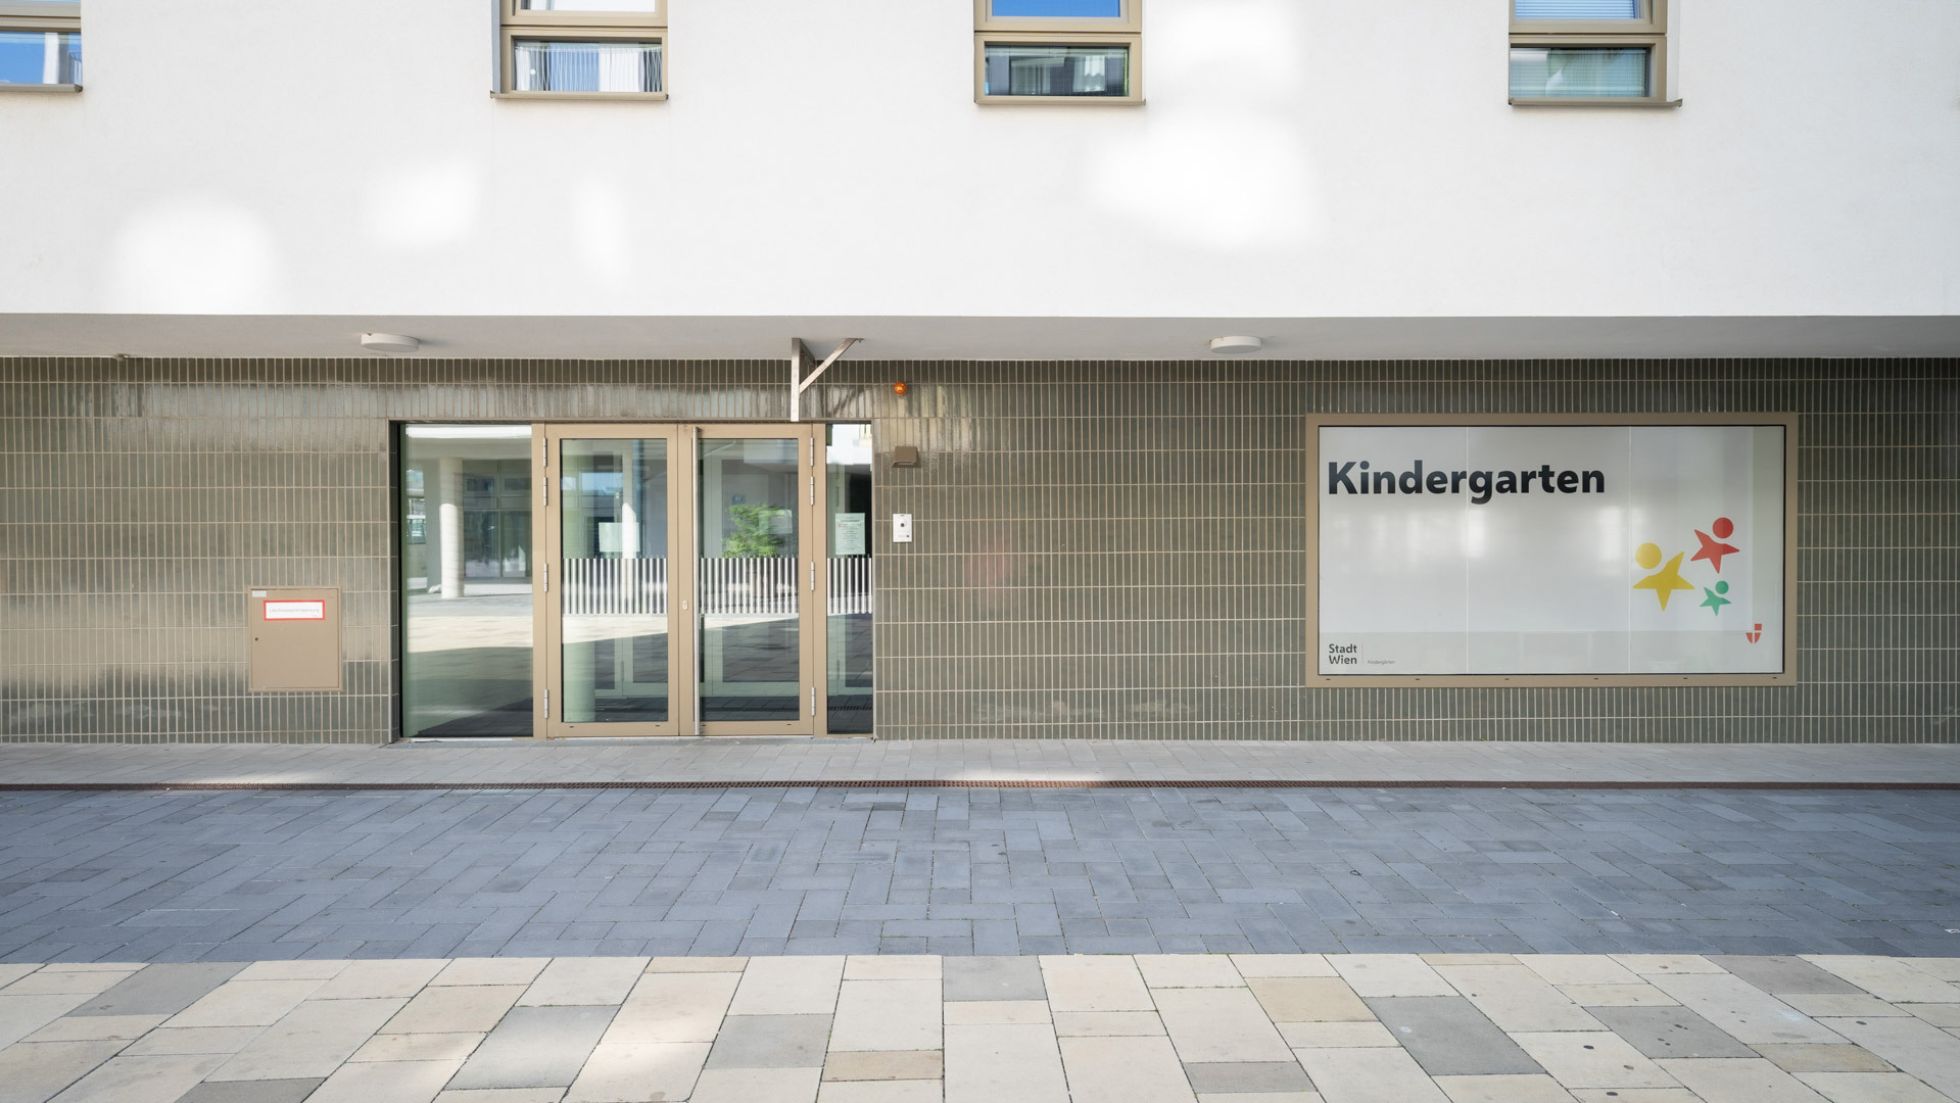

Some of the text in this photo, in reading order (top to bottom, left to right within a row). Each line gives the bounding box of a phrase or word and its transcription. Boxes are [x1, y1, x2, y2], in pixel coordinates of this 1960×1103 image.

[1328, 459, 1605, 505] Kindergarten
[1328, 643, 1357, 654] Stadt
[1328, 655, 1357, 665] Wien
